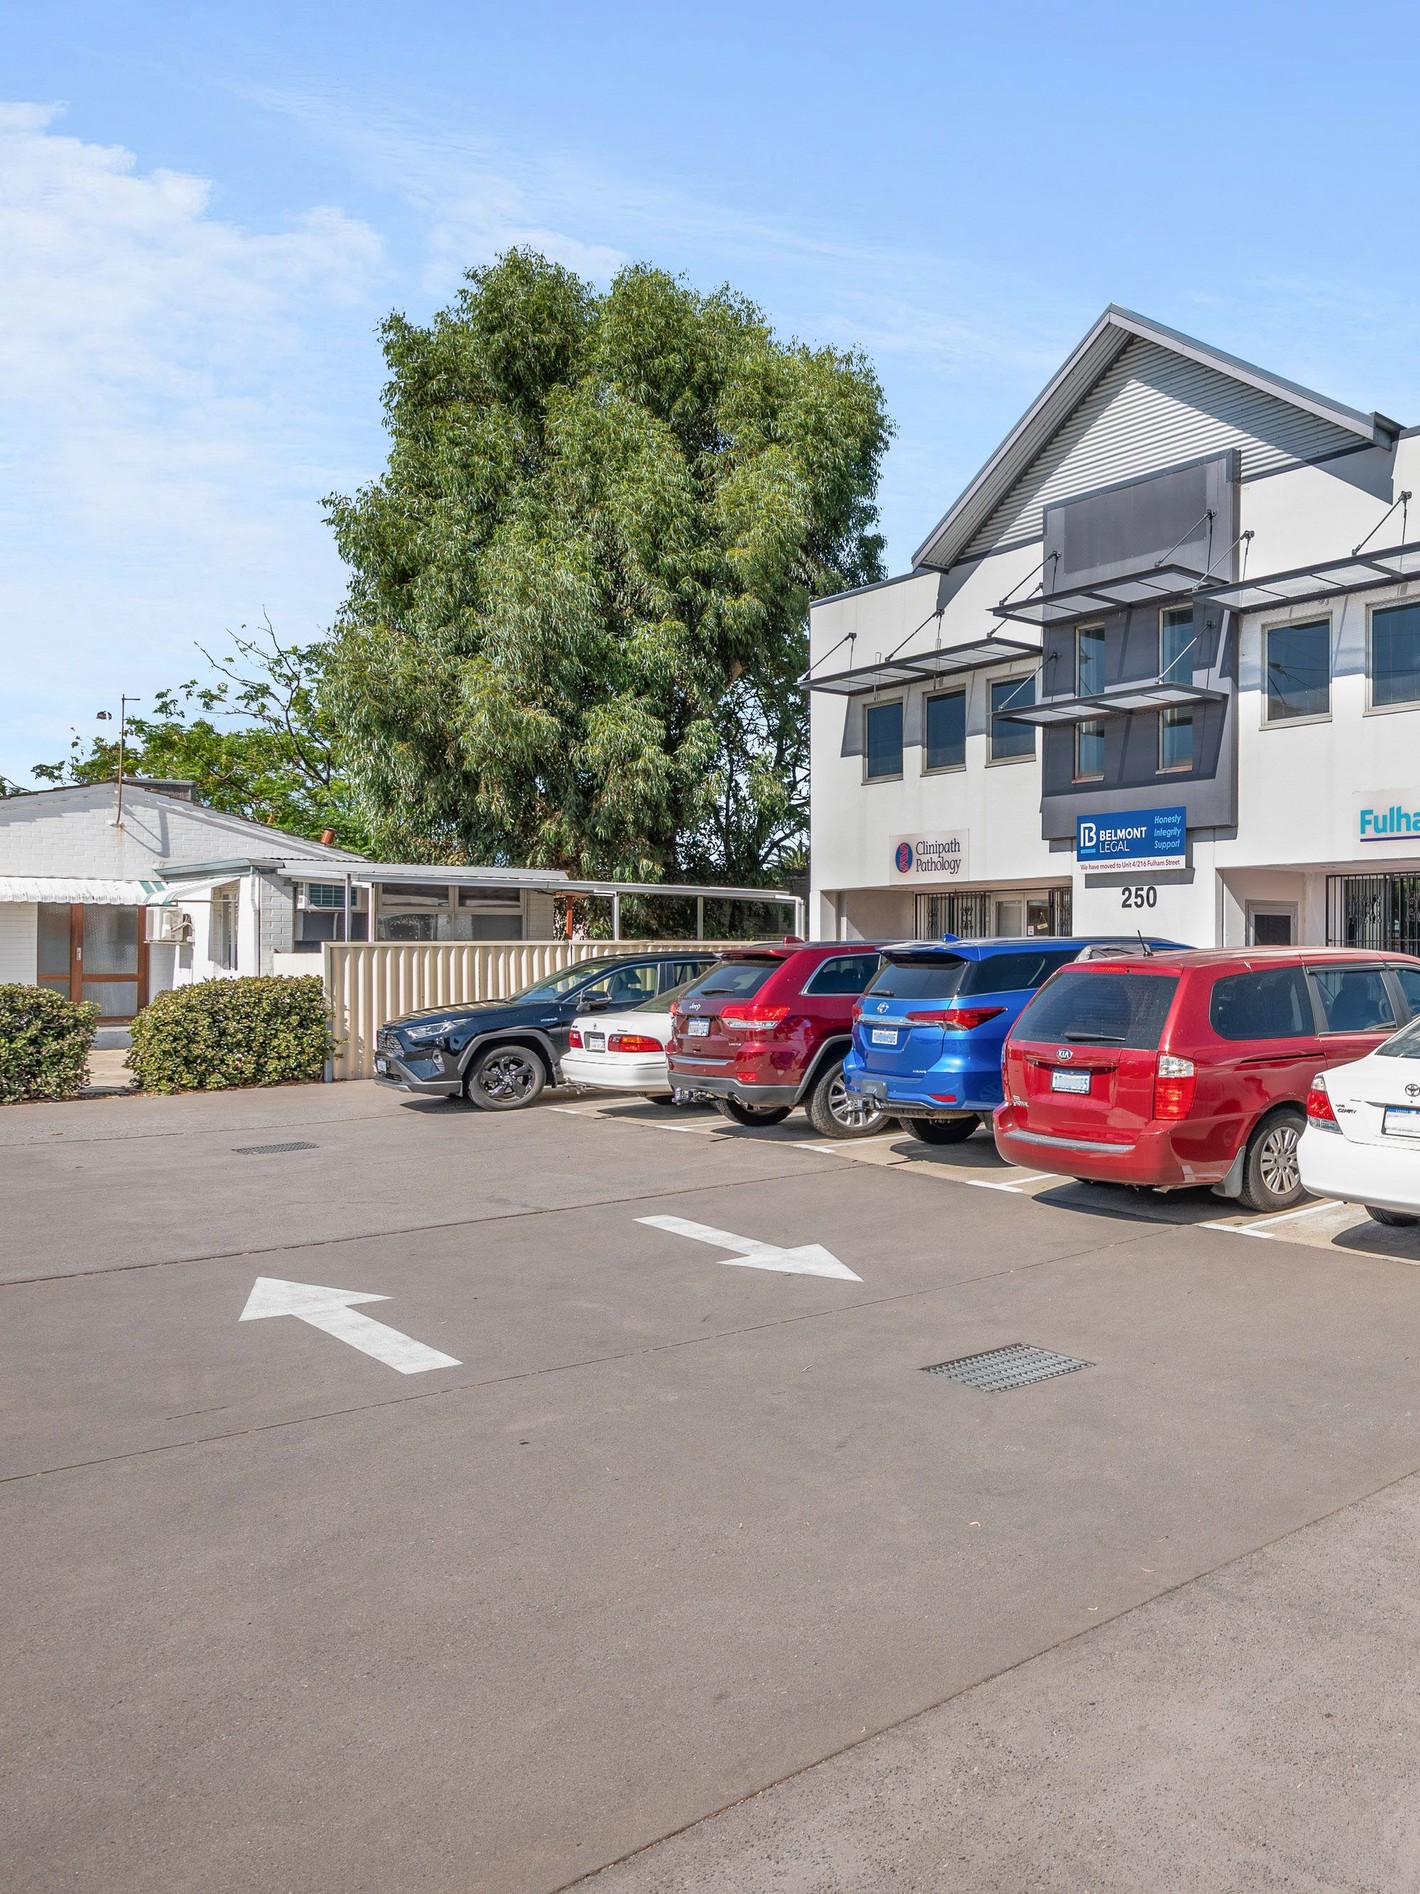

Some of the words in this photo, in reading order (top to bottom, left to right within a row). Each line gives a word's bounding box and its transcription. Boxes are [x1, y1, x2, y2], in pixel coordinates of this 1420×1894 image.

[1154, 814, 1182, 825] Honesty
[1099, 827, 1147, 841] BELMONT
[1154, 827, 1181, 838] Integrity
[916, 838, 961, 858] Clinipath
[1099, 840, 1130, 853] LEGAL
[1154, 839, 1180, 850] Support
[916, 856, 962, 875] Pathology
[1132, 860, 1147, 868] 4/216
[1147, 859, 1165, 867] Fulham
[1121, 885, 1158, 909] 250
